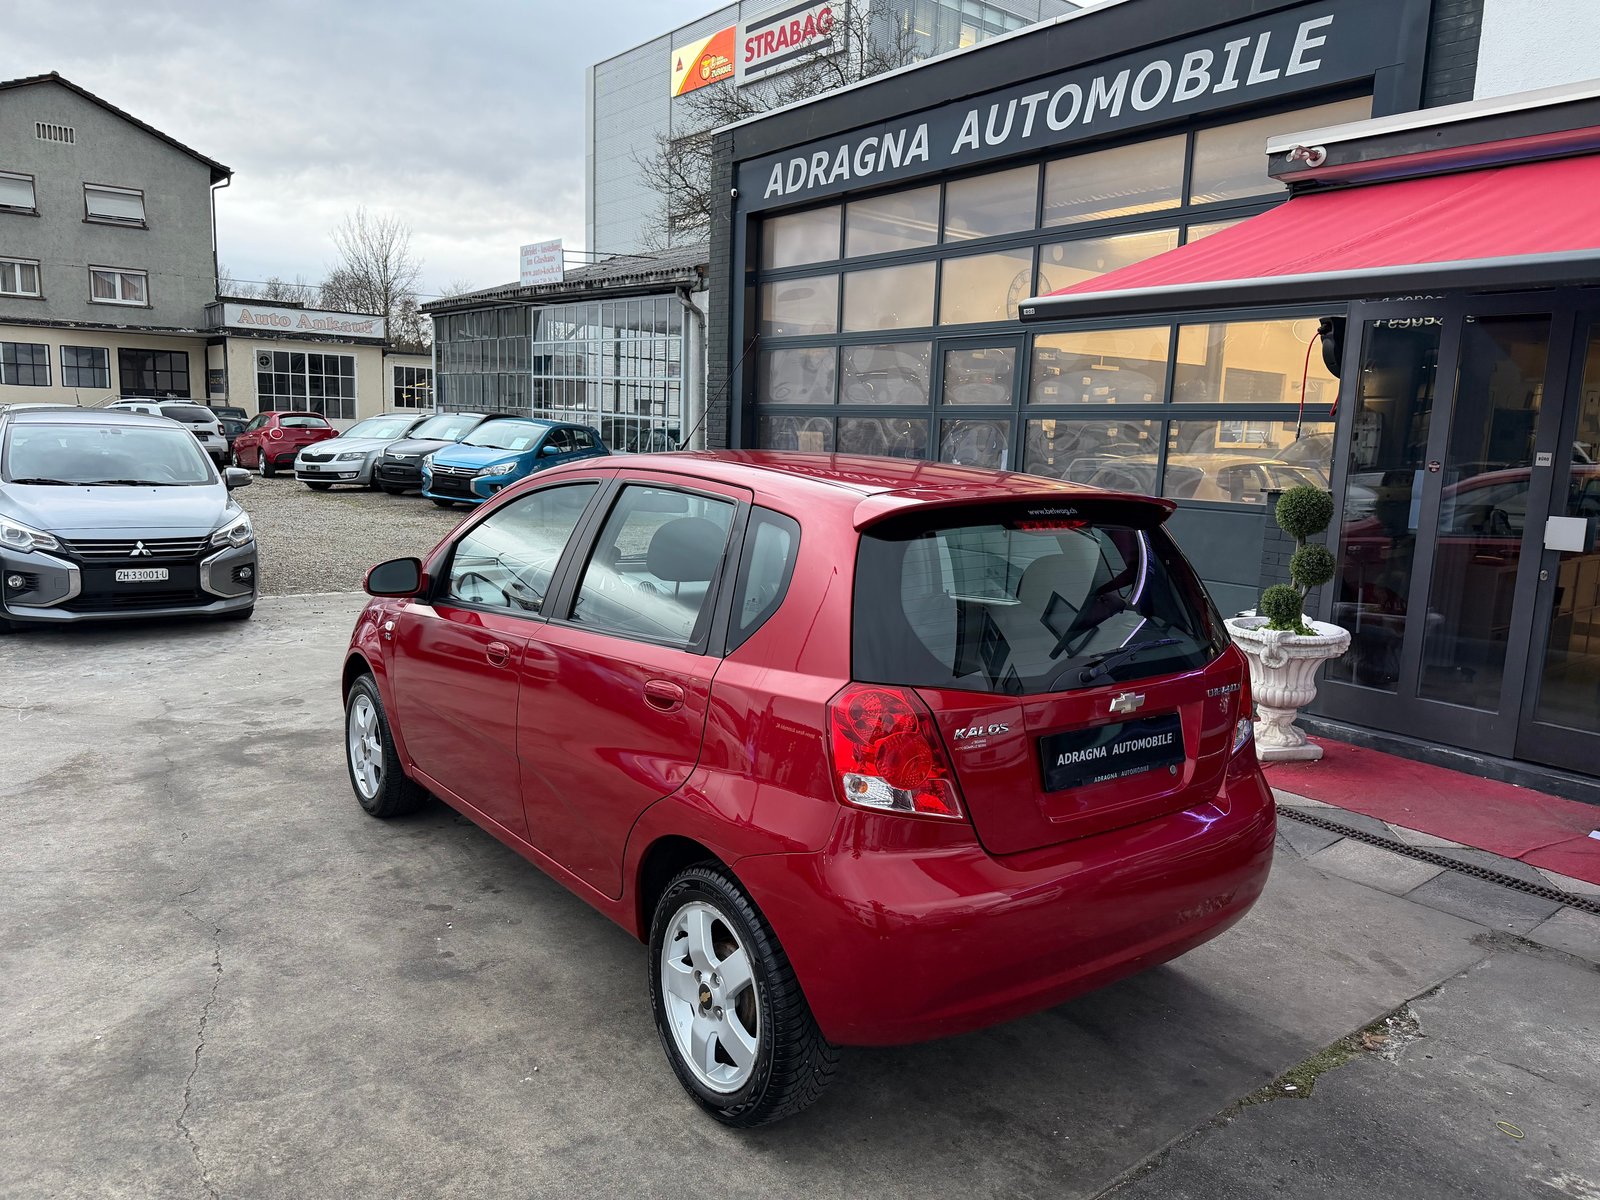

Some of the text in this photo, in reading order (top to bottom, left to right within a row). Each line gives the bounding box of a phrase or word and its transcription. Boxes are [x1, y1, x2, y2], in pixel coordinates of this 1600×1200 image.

[745, 8, 833, 62] STRABAG
[764, 14, 1334, 199] ADRAGNA AUTOMOBILE
[238, 309, 373, 334] Auto Ankauf
[953, 722, 1009, 740] KALOS
[1056, 732, 1173, 766] ADRAGNA AUTOMOBILE
[1093, 764, 1149, 783] ADRAGNA AUTOMOBILE
